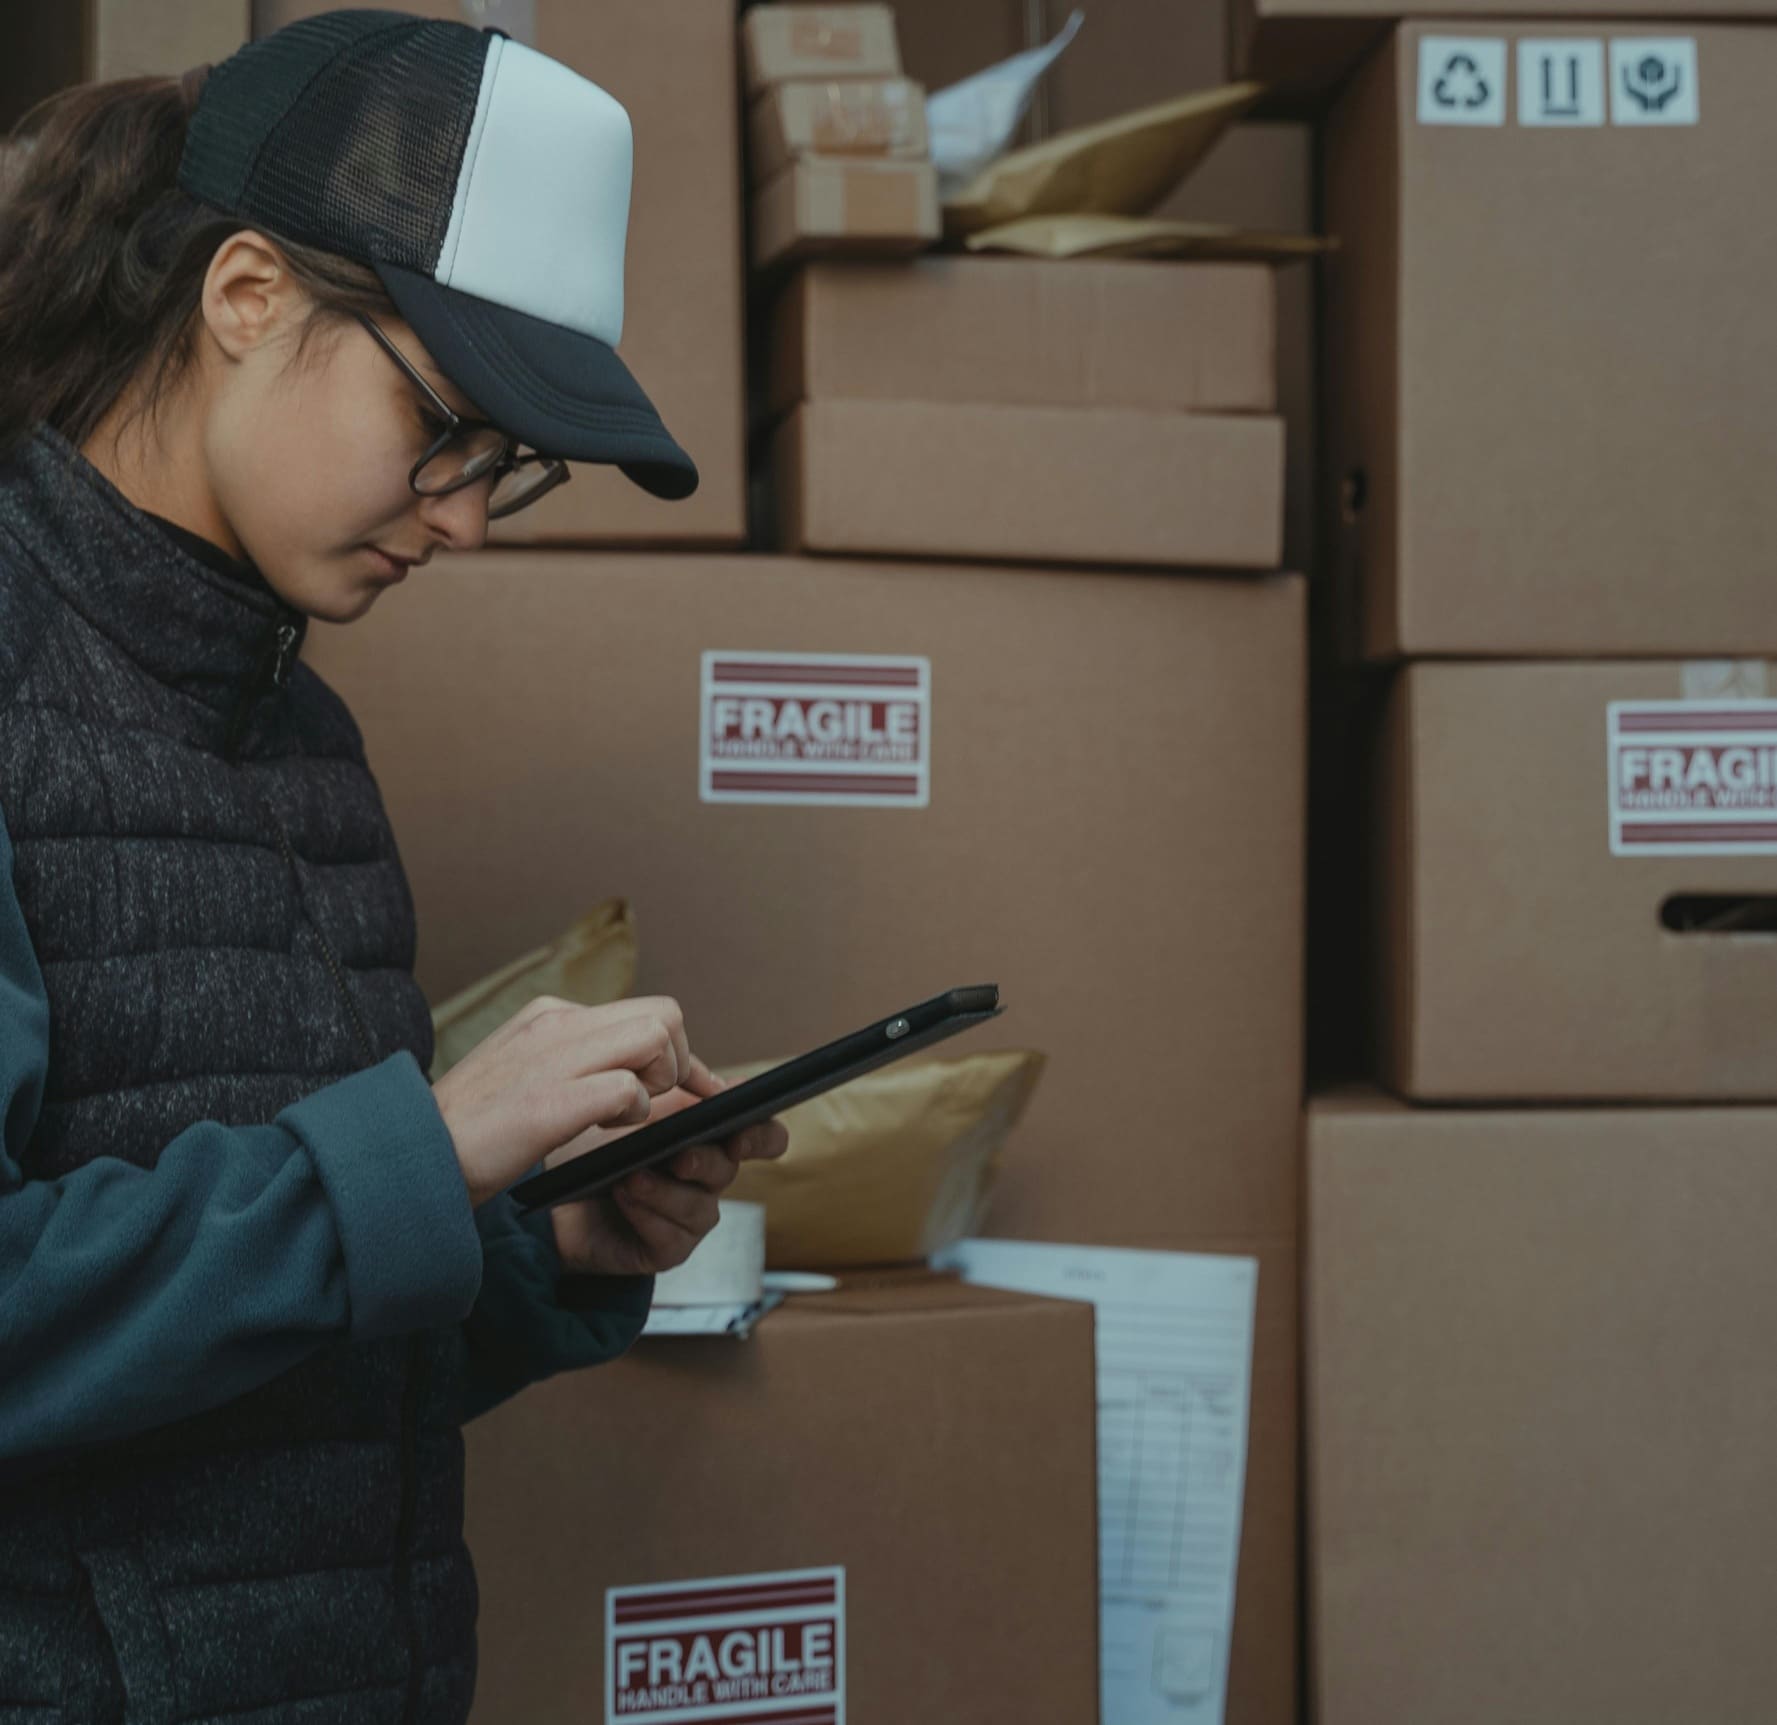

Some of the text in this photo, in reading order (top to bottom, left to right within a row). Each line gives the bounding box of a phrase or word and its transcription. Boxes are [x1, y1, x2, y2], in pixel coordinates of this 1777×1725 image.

[714, 700, 915, 742] FRAGILE
[1622, 749, 1777, 790] FRAGI
[618, 1624, 833, 1688] FRAGILE
[617, 1668, 832, 1711] HANDLE WITH CARE
